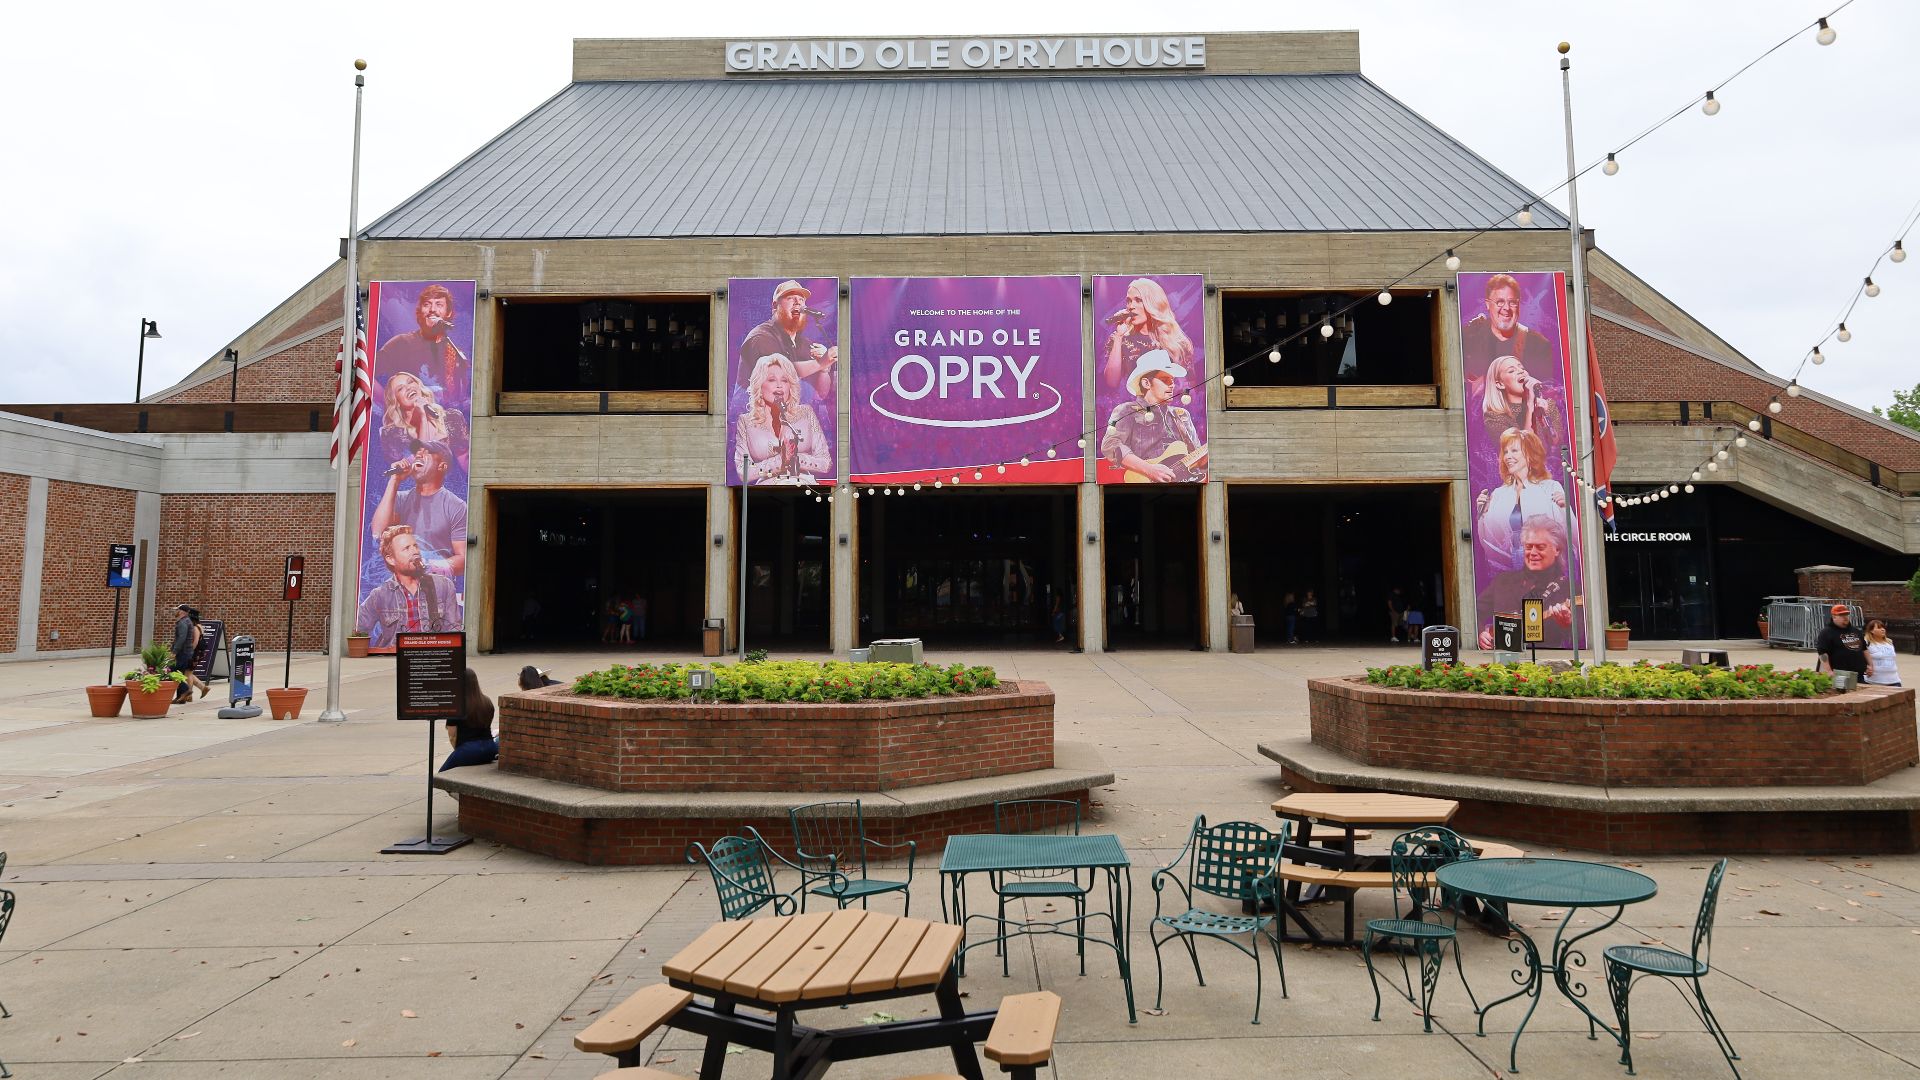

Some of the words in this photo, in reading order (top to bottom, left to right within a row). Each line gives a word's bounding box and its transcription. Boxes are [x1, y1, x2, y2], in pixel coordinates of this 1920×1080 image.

[727, 41, 865, 71] GRAND
[875, 40, 950, 69] OLE
[961, 39, 1065, 68] OPRY
[1075, 37, 1205, 67] HOUSE
[894, 328, 984, 347] GRAND
[992, 328, 1041, 346] OLE
[890, 354, 1041, 400] OPRY
[1604, 533, 1619, 541] HE
[1621, 533, 1657, 541] CIRCLE
[1658, 532, 1691, 541] ROOM
